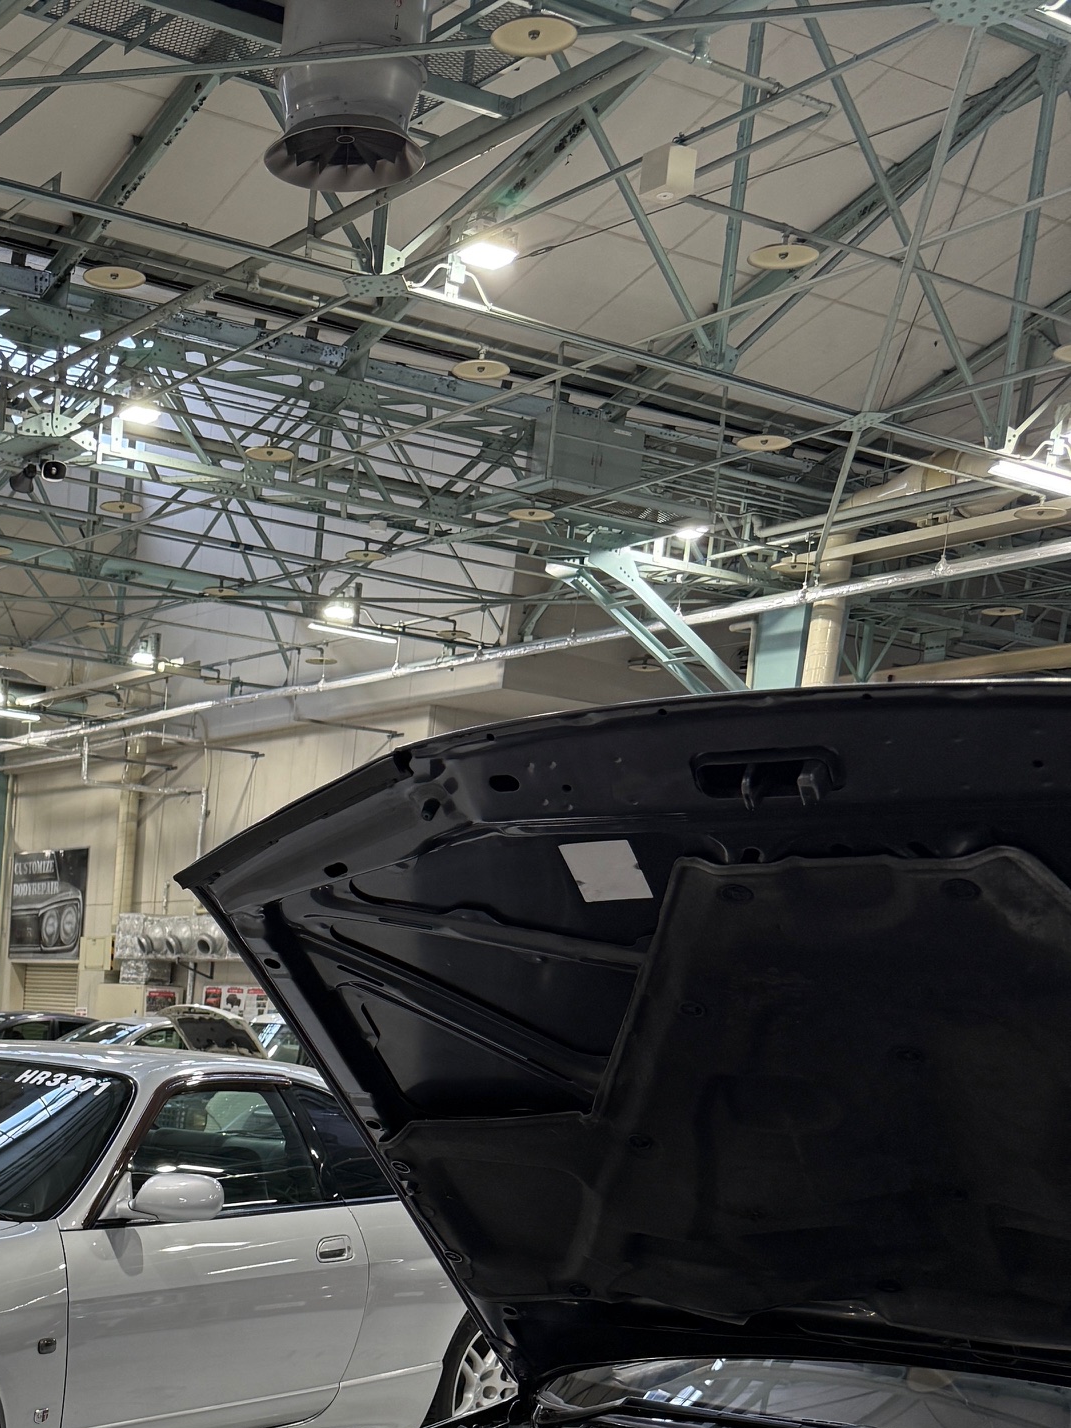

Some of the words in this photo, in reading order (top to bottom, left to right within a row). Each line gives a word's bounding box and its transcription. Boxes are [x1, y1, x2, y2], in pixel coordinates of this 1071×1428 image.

[14, 860, 55, 875] CUSTOMIZE
[13, 881, 59, 896] BODYREPAIR
[14, 1069, 112, 1097] HR3301
